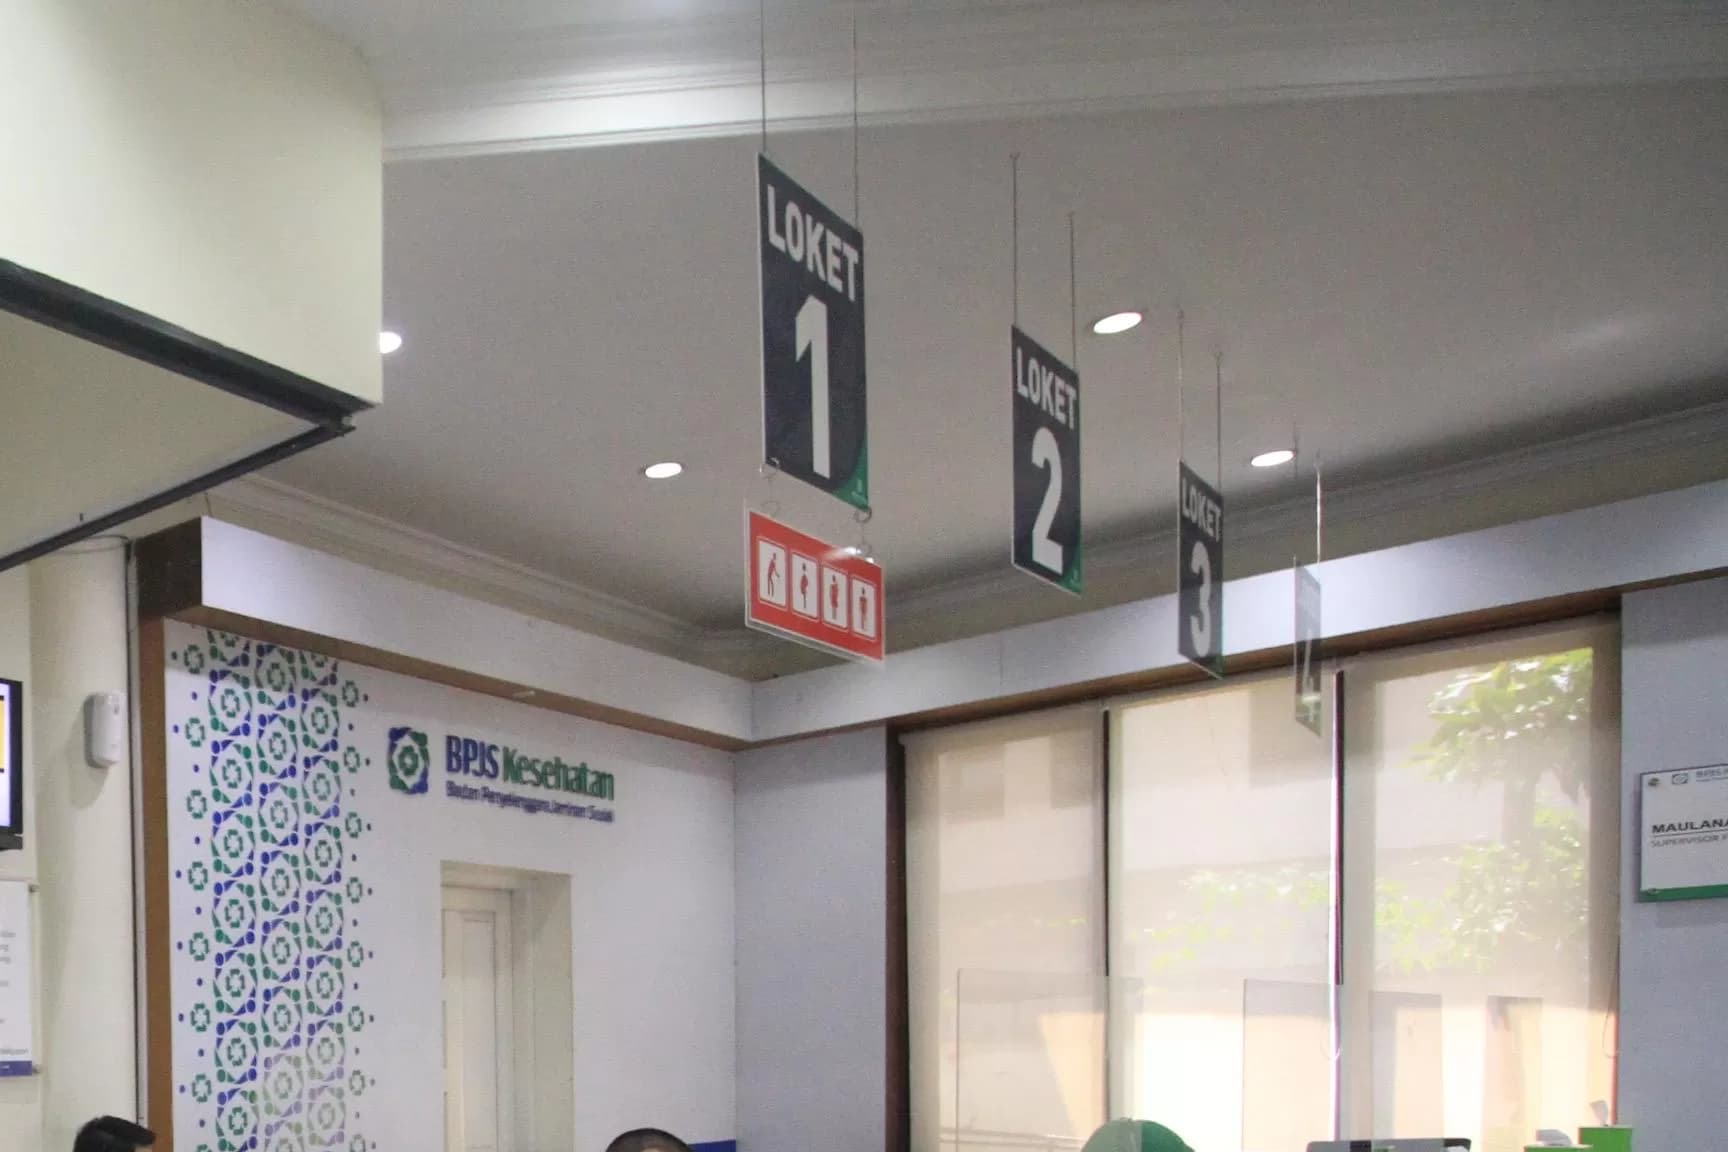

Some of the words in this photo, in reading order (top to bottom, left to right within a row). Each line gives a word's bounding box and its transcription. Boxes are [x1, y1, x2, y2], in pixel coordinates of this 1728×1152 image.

[767, 183, 859, 302] LOKET
[795, 295, 830, 479] 1
[1016, 346, 1077, 430] LOKET
[1031, 426, 1063, 575] 2
[1181, 477, 1222, 542] LOKET
[1190, 541, 1211, 658] 3
[445, 735, 500, 779] BPJS
[502, 746, 615, 801] Kesehatan
